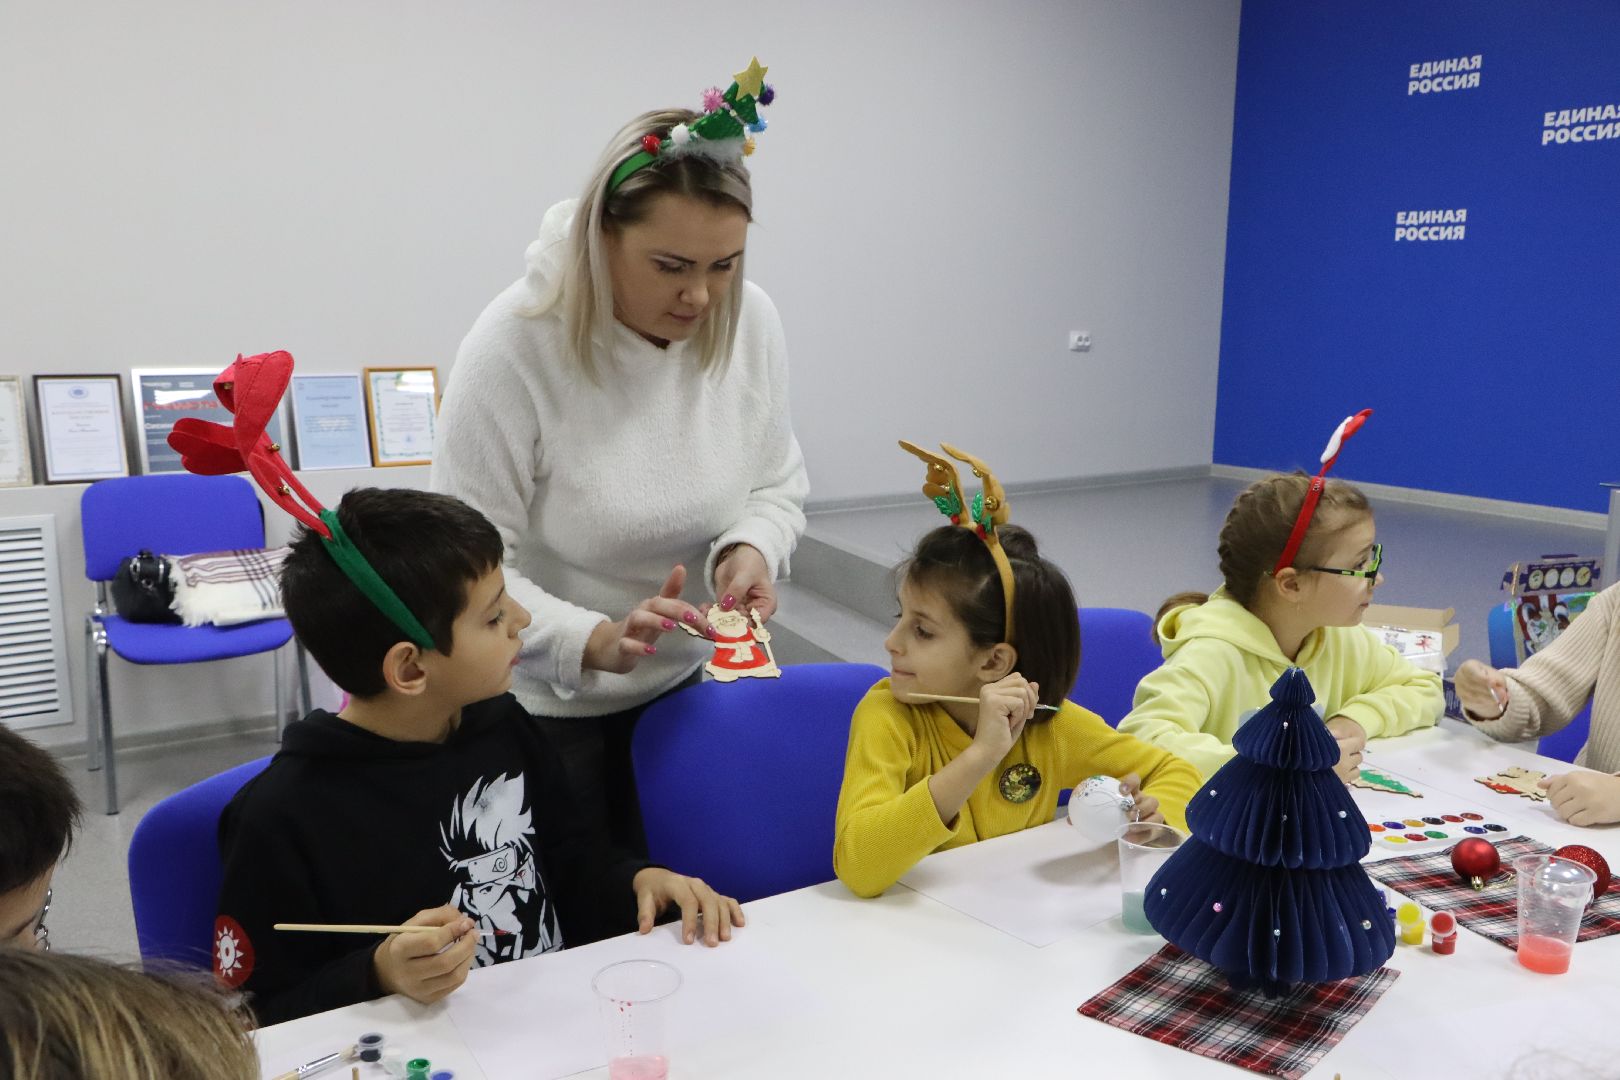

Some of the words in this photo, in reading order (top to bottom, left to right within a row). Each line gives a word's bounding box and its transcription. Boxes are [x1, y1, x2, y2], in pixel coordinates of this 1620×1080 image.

[1409, 54, 1482, 79] ЕДИНАЯ
[1407, 72, 1480, 95] РОССИЯ
[1544, 104, 1620, 127] ЕДИНА
[1396, 209, 1467, 226] ЕДИНАЯ
[1394, 225, 1466, 241] РОССИЯ
